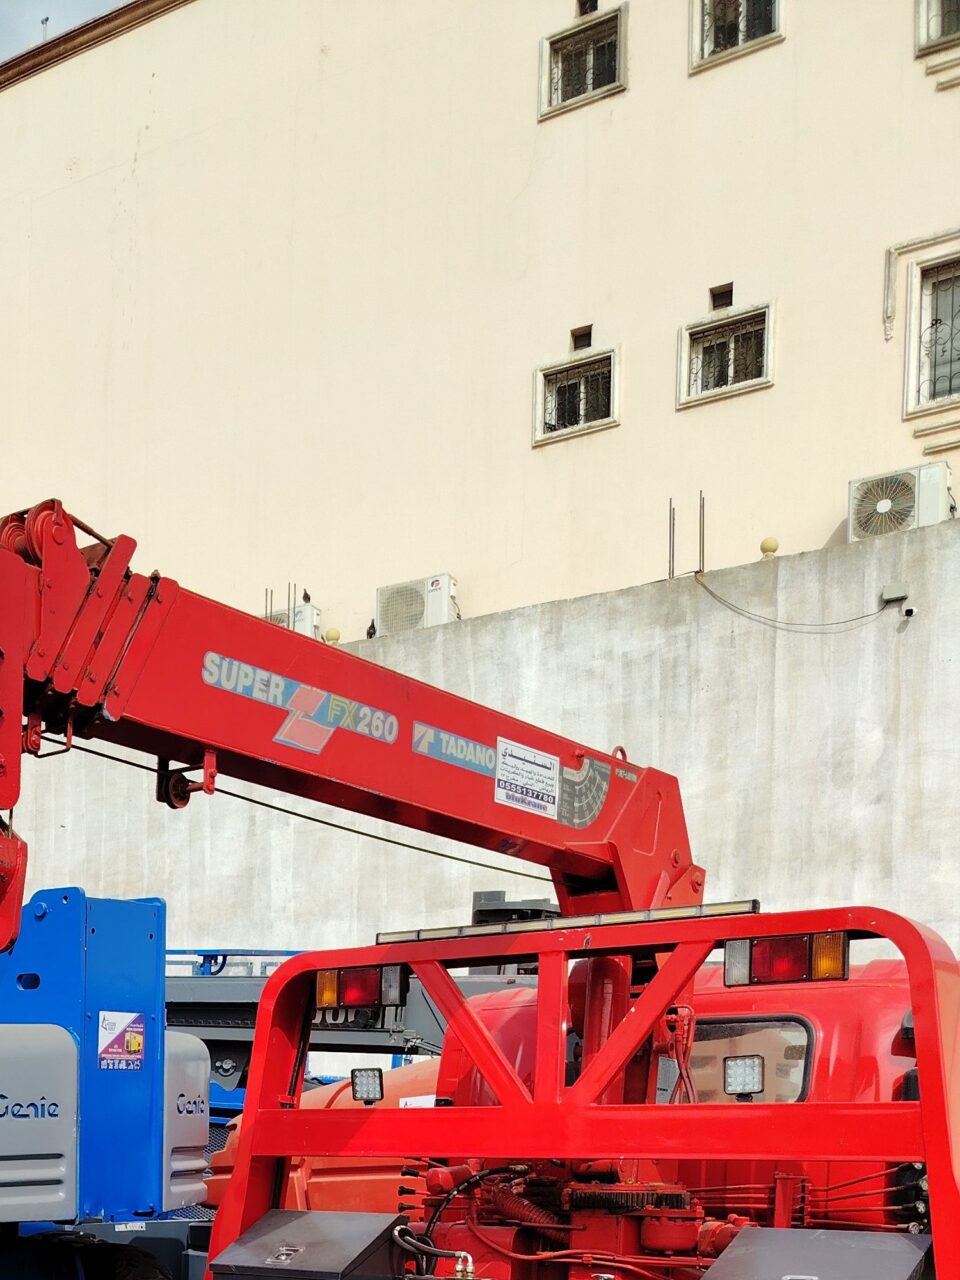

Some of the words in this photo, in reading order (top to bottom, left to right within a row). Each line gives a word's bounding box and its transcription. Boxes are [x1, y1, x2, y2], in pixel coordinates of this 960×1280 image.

[202, 651, 284, 705] SUPER
[440, 733, 496, 769] TADANO
[500, 781, 553, 803] 0555137780
[177, 1093, 205, 1115] Genie
